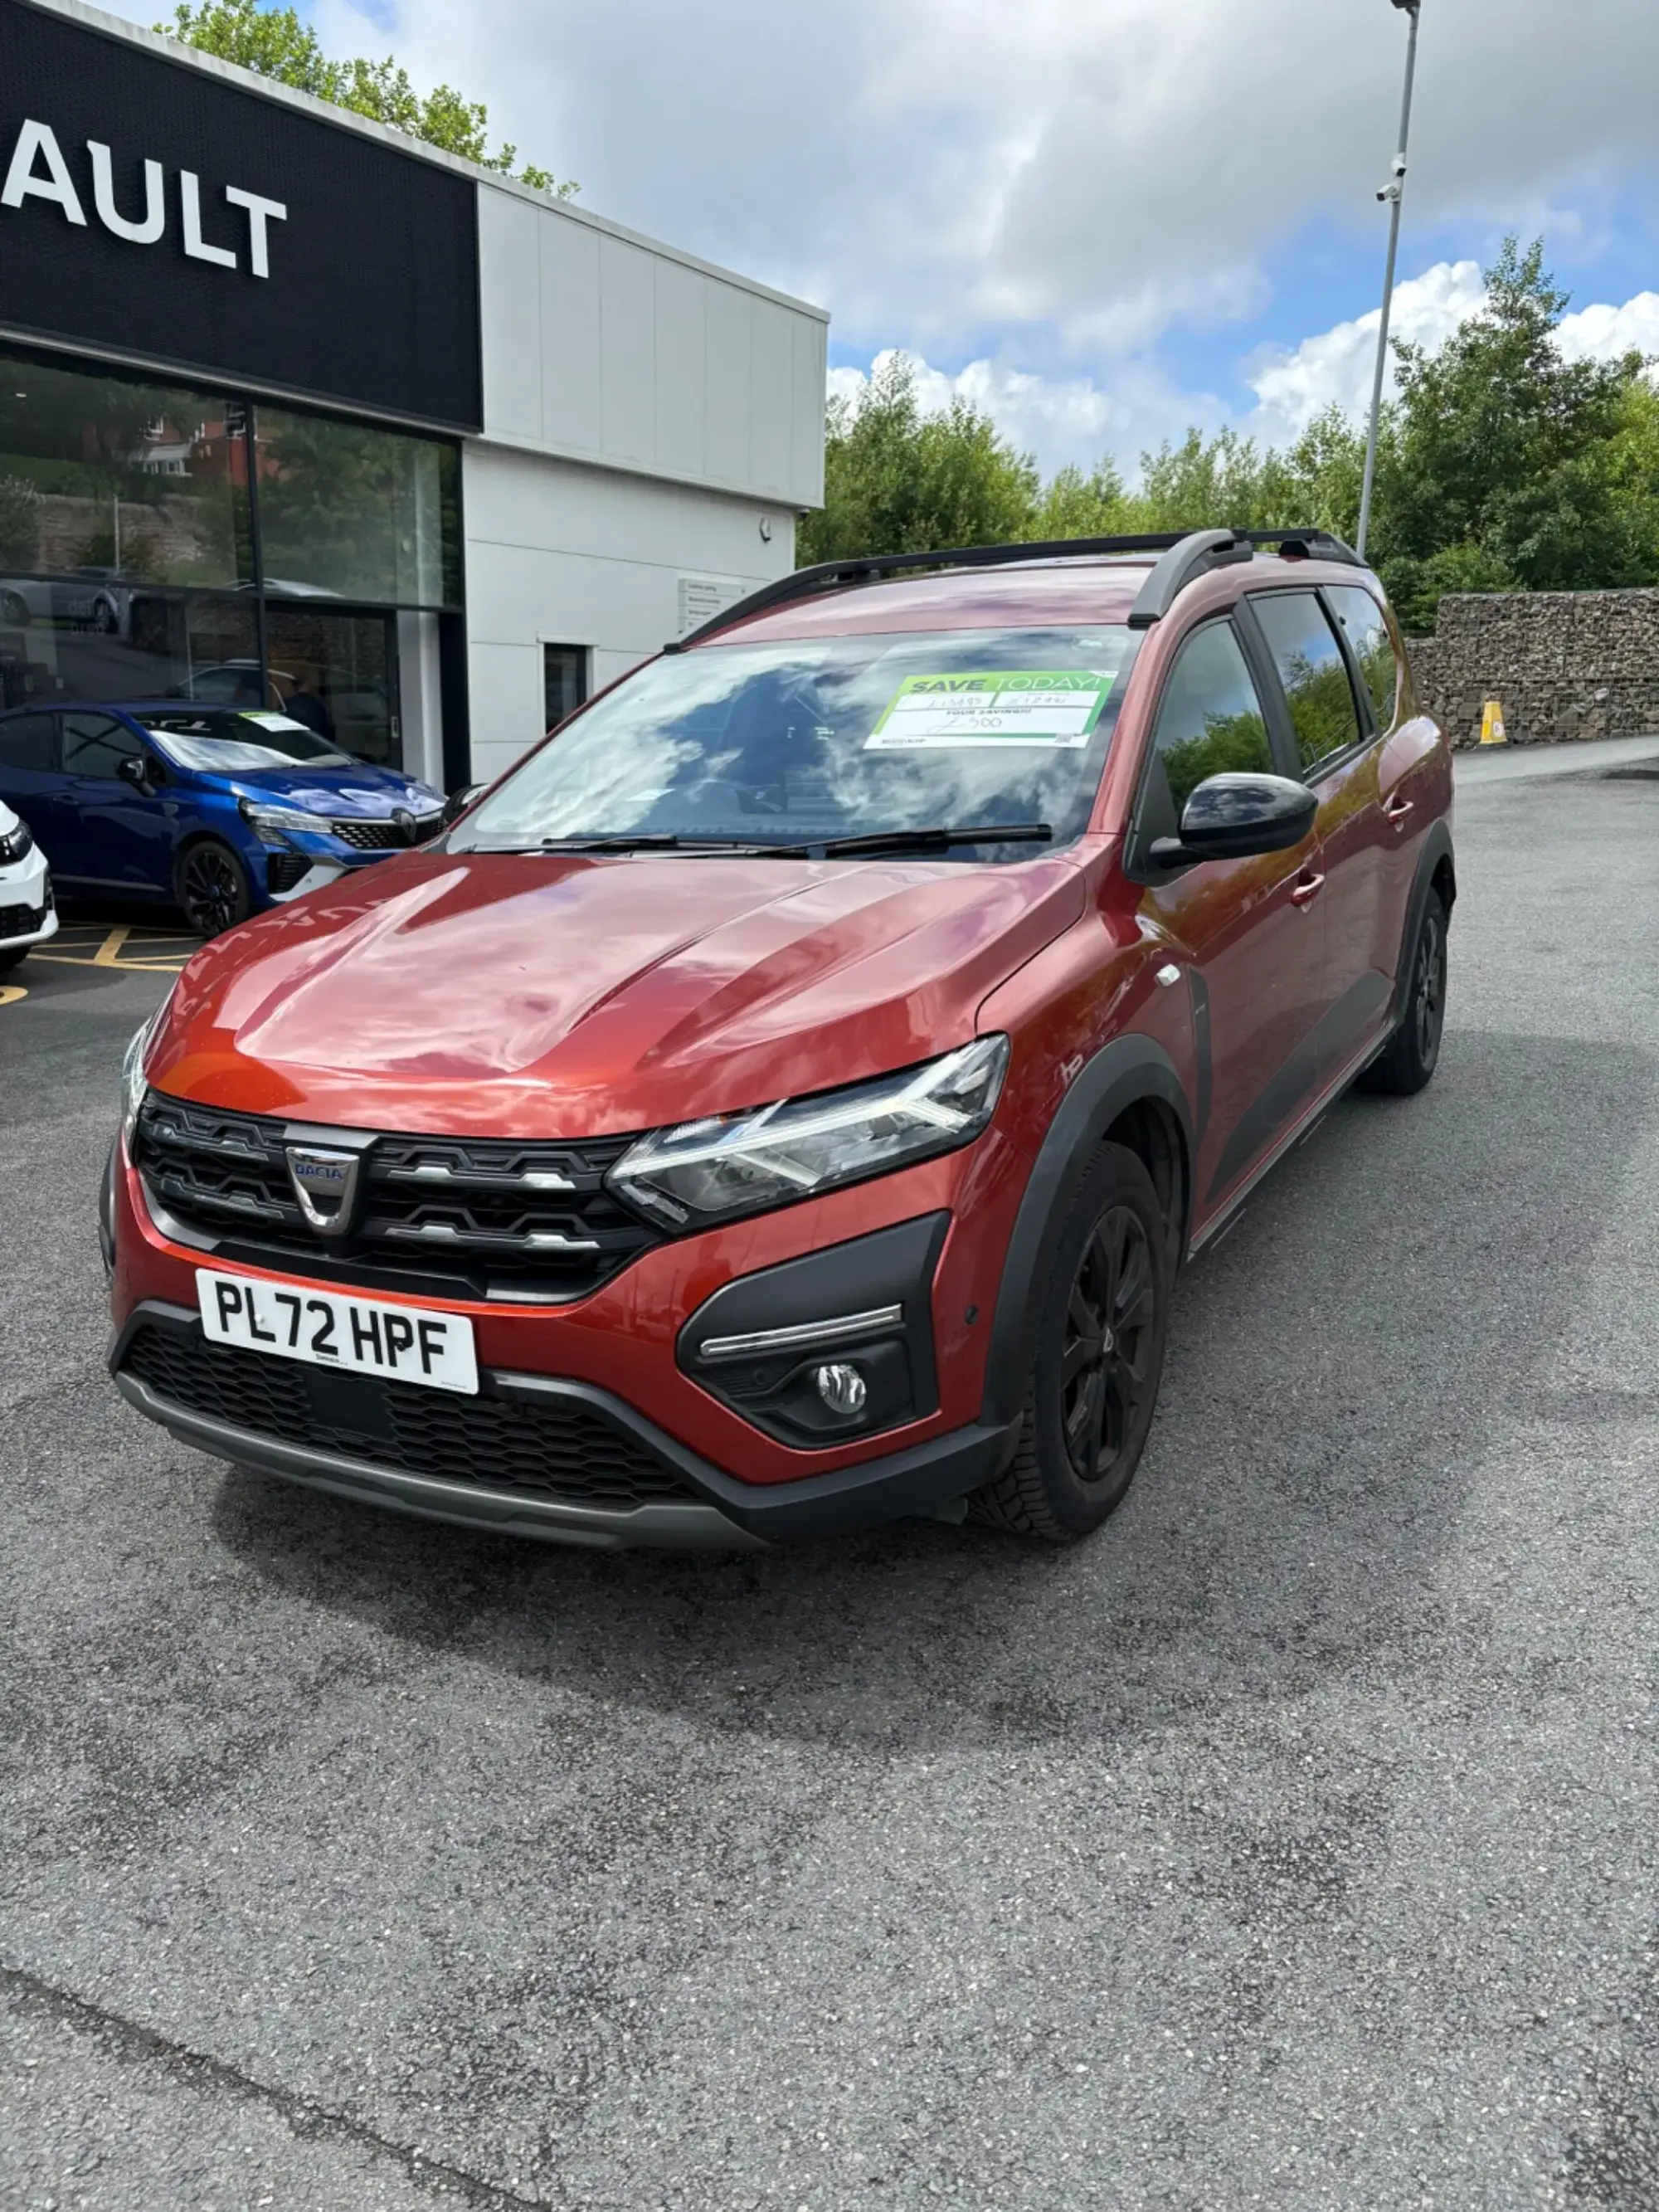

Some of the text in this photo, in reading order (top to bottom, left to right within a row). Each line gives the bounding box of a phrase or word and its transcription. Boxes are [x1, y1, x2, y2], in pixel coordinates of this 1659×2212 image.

[1, 119, 287, 279] AULT
[909, 676, 1101, 693] SAVE TODAY!
[294, 1164, 343, 1178] DACIA
[215, 1281, 447, 1374] PL72 HPF
